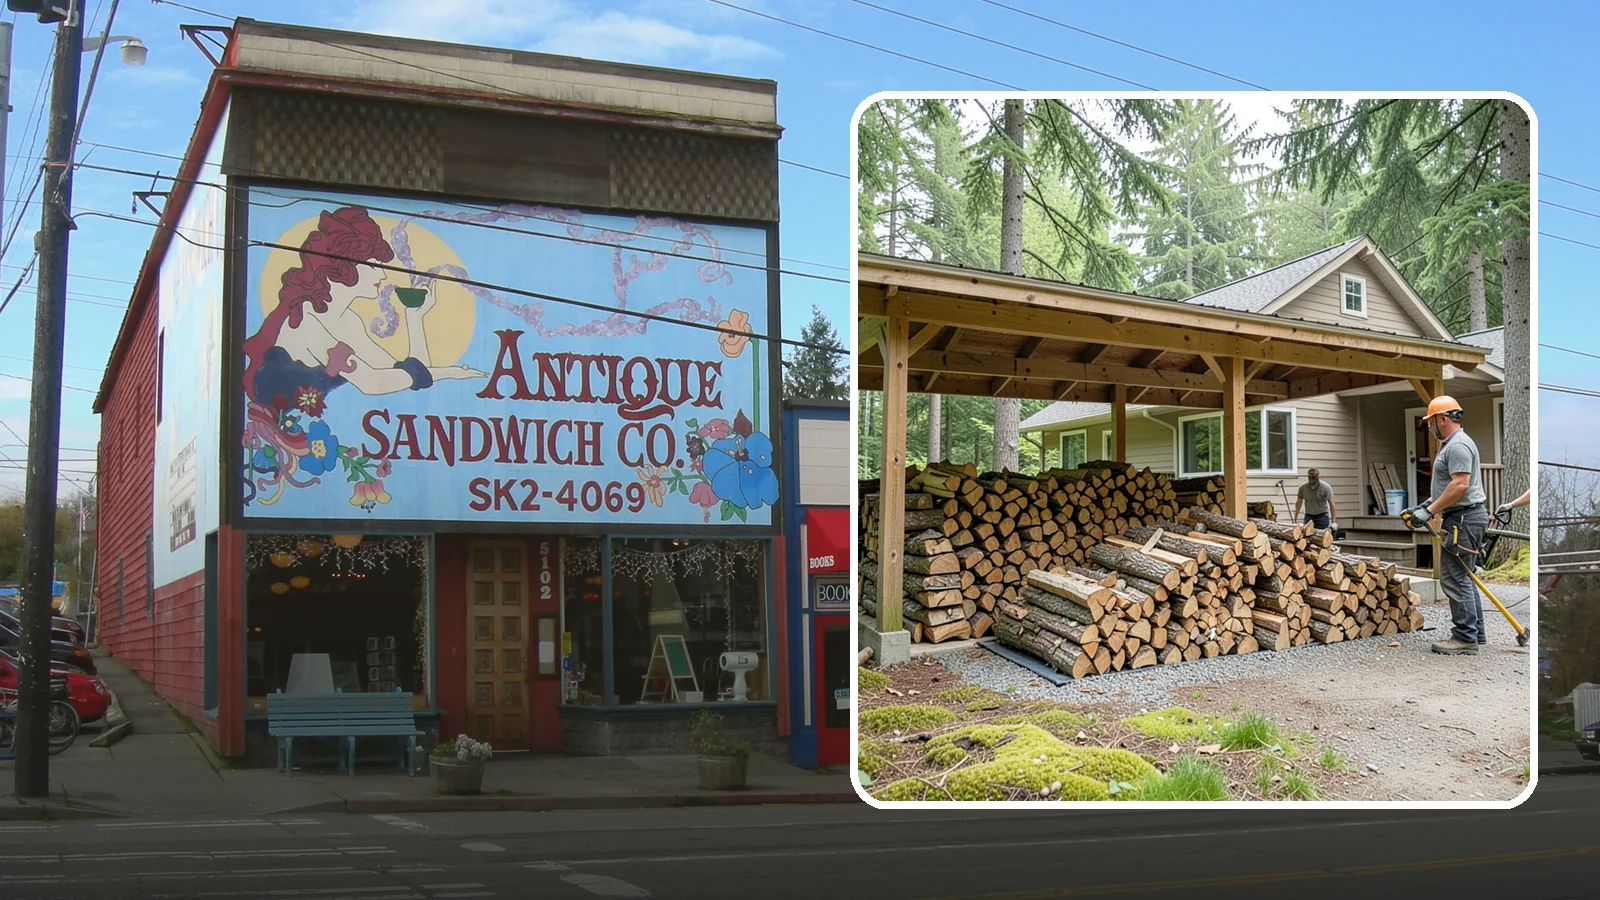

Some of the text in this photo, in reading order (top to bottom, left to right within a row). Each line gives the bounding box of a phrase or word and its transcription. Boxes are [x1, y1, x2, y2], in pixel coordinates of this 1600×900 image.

[475, 329, 724, 421] ANTIQUE
[361, 408, 685, 469] SANDWICH CO.
[468, 477, 646, 513] SK2-4069
[539, 541, 552, 600] 5102
[809, 555, 835, 569] BOOKS
